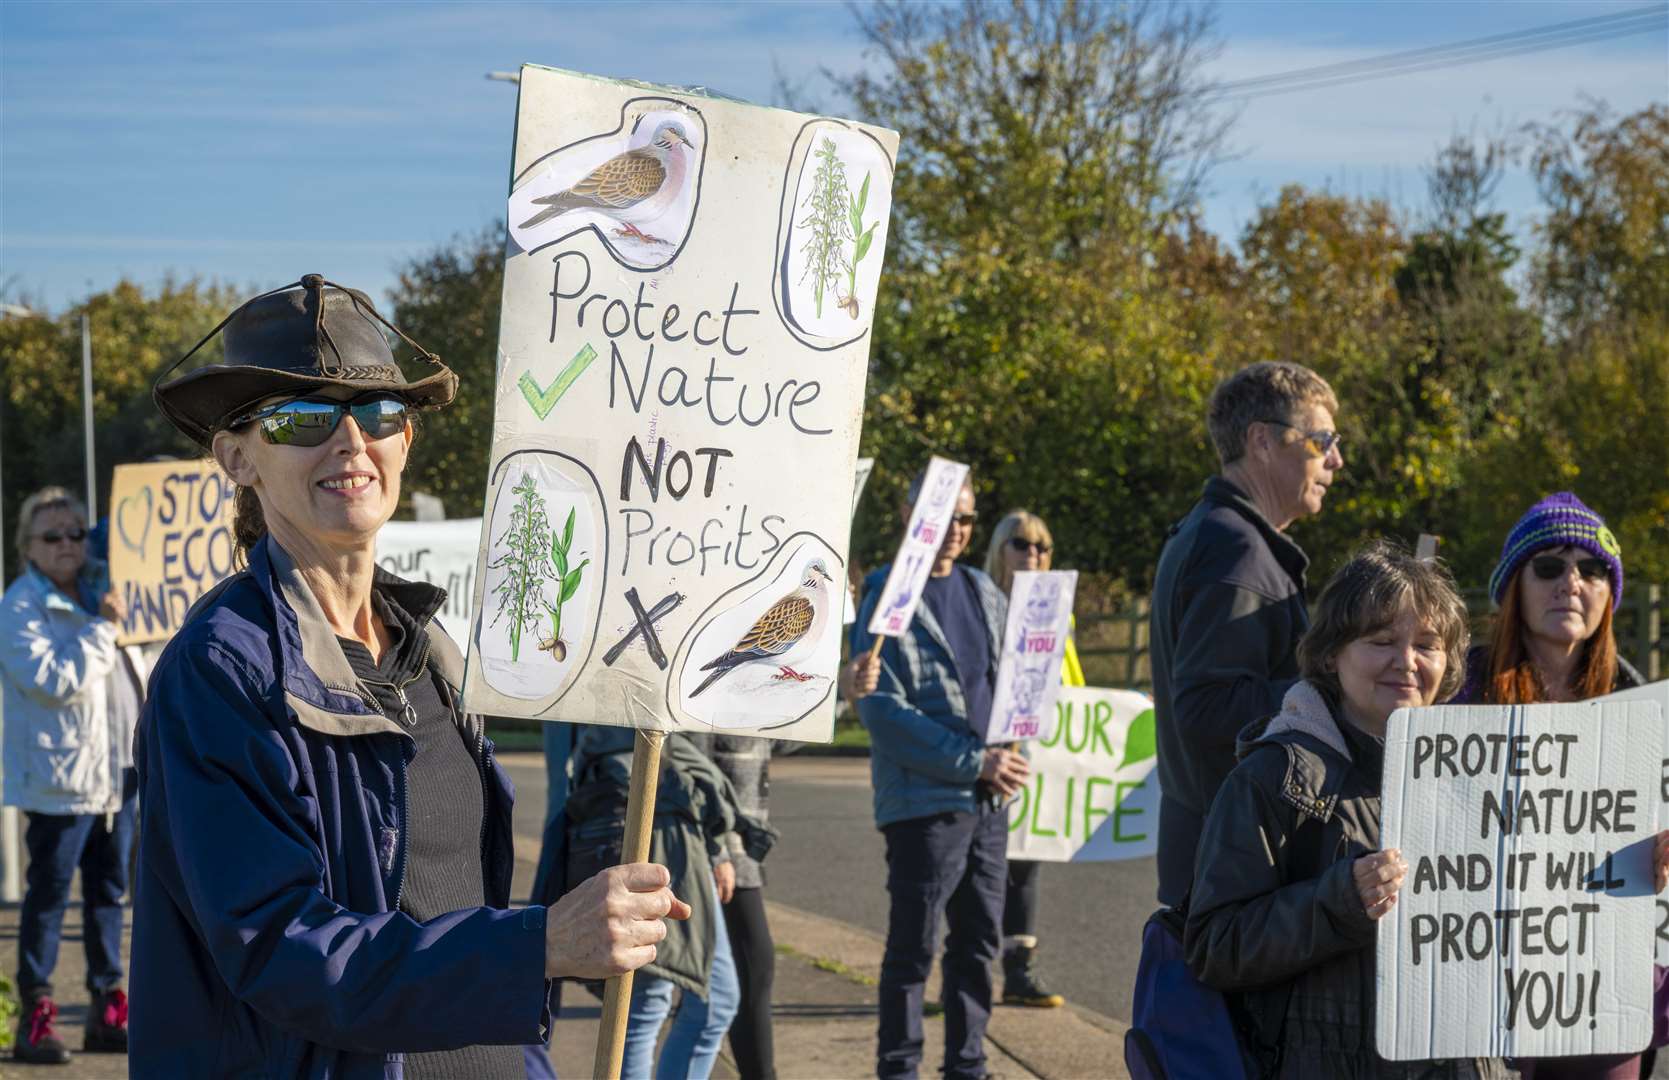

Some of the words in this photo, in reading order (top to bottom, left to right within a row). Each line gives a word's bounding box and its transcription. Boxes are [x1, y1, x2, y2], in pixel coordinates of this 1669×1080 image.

[549, 251, 759, 356] Protect
[609, 340, 833, 435] Nature
[620, 436, 734, 503] NOT
[164, 527, 233, 585] ECO
[619, 504, 785, 576] Profits
[1027, 637, 1056, 654] YOU
[1013, 721, 1039, 737] YOU
[1413, 733, 1578, 779] PROTECT
[1481, 789, 1637, 839] NATURE
[1413, 854, 1492, 894] AND
[1506, 852, 1537, 892] IT
[1546, 851, 1625, 892] WILL
[1411, 903, 1600, 966] PROTECT
[1504, 968, 1600, 1031] YOU!
